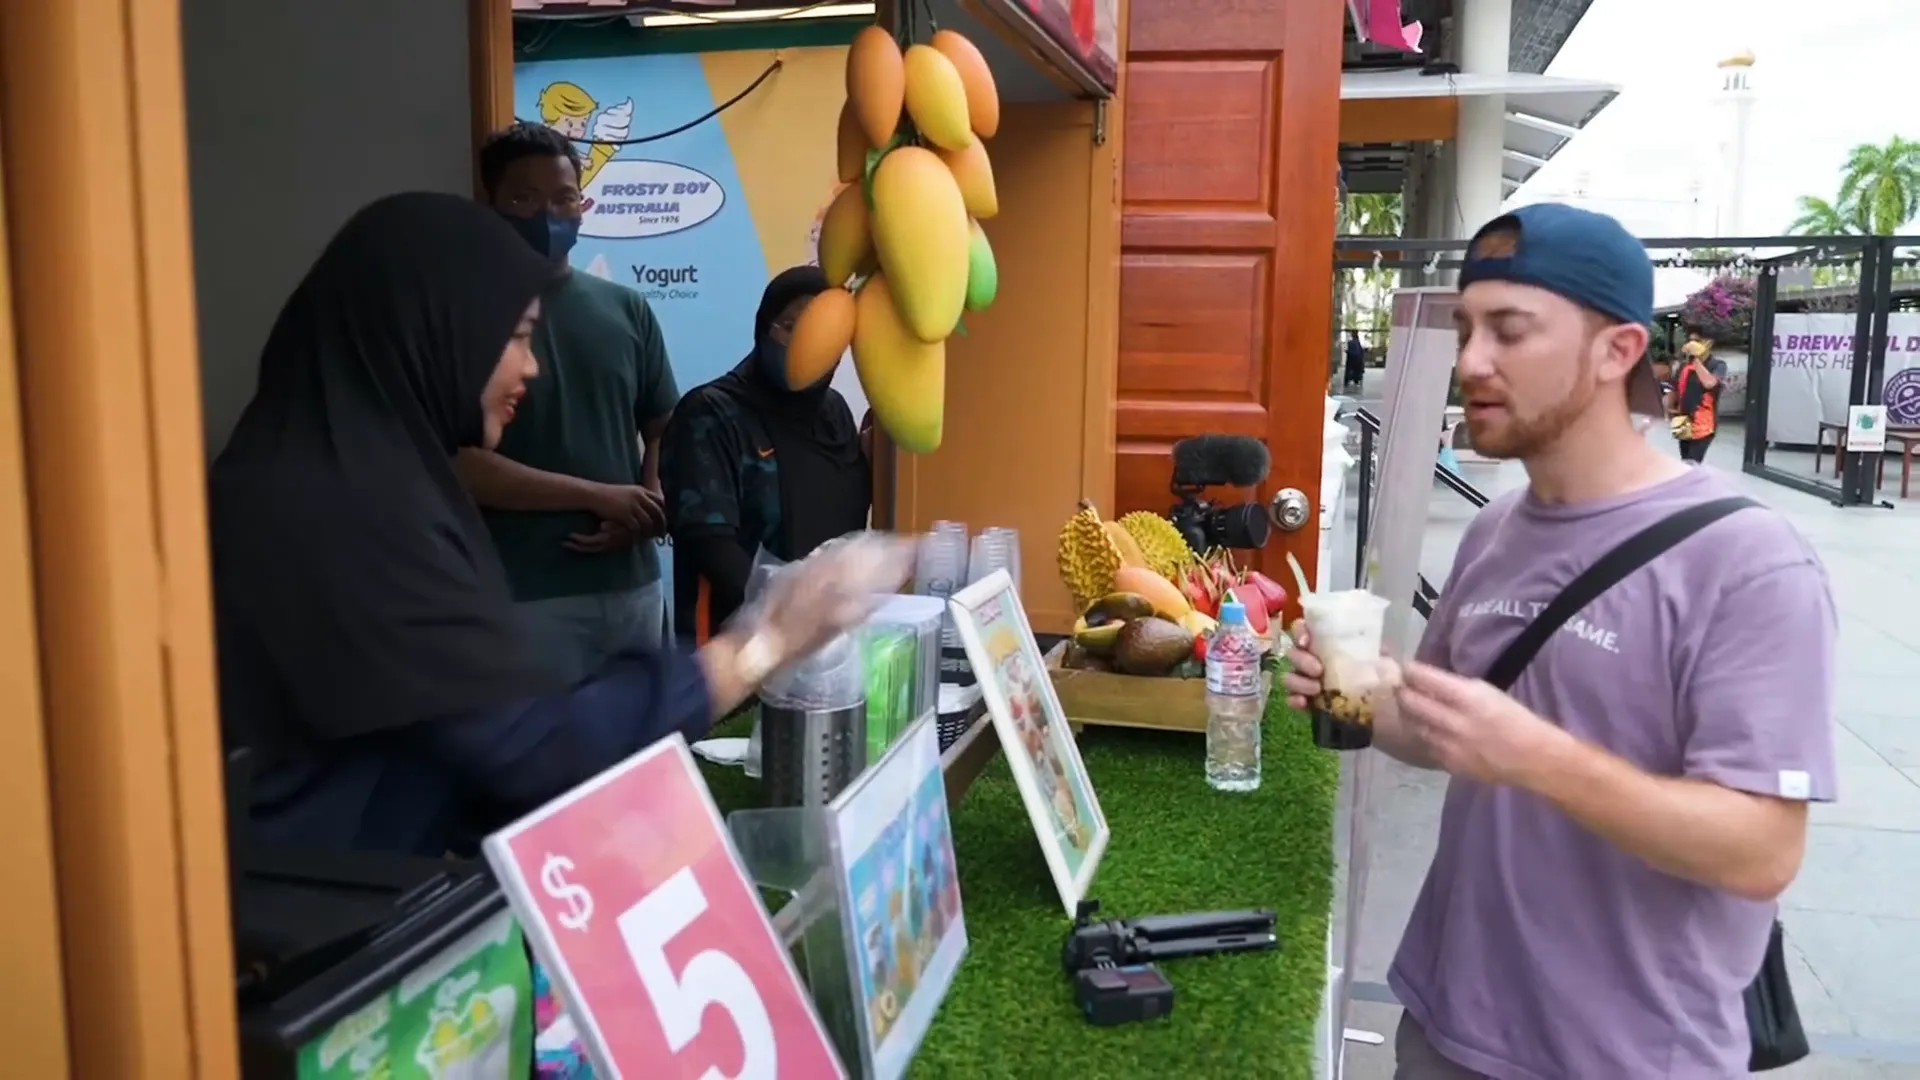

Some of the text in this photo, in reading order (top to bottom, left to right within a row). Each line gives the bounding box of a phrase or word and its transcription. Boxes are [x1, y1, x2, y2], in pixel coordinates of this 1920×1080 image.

[601, 182, 710, 196] FROSTY BOY
[594, 202, 680, 214] AUSTRALIA
[639, 215, 680, 224] Since 1976
[631, 264, 698, 287] Yogurt
[640, 289, 698, 300] ealthy Choice
[1492, 599, 1526, 618] ALL
[1563, 616, 1620, 653] SAME.
[541, 852, 777, 1080] $ 5
